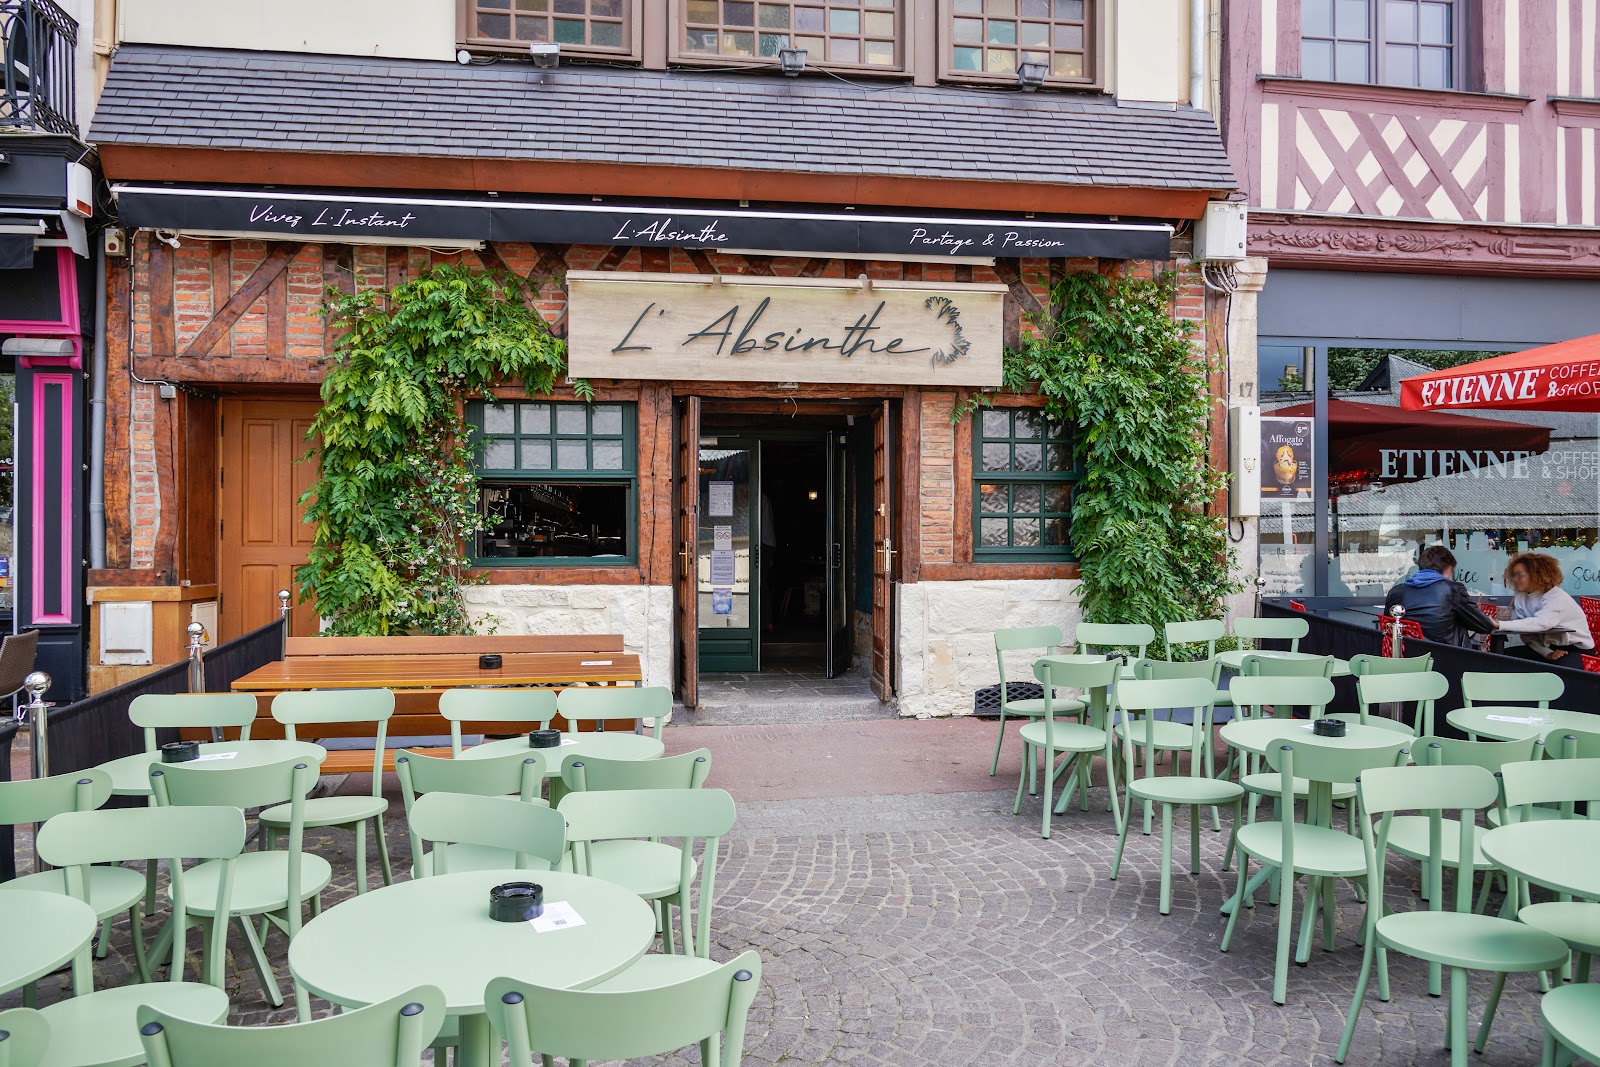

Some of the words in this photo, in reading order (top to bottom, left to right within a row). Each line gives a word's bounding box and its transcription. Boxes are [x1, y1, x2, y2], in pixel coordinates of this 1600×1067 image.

[250, 205, 303, 228] Vivez
[612, 217, 729, 242] L'Absinthe
[909, 228, 975, 255] Partage
[982, 233, 994, 246] &
[1001, 231, 1065, 248] Passion
[1549, 362, 1600, 379] COFFE
[1238, 382, 1254, 398] 17
[1421, 368, 1545, 407] ETIENNE
[1269, 434, 1305, 446] Affogato
[1378, 449, 1532, 479] ETIENNE
[1541, 451, 1599, 465] COFFEE
[1541, 465, 1551, 479] &
[1556, 465, 1599, 480] SHOP
